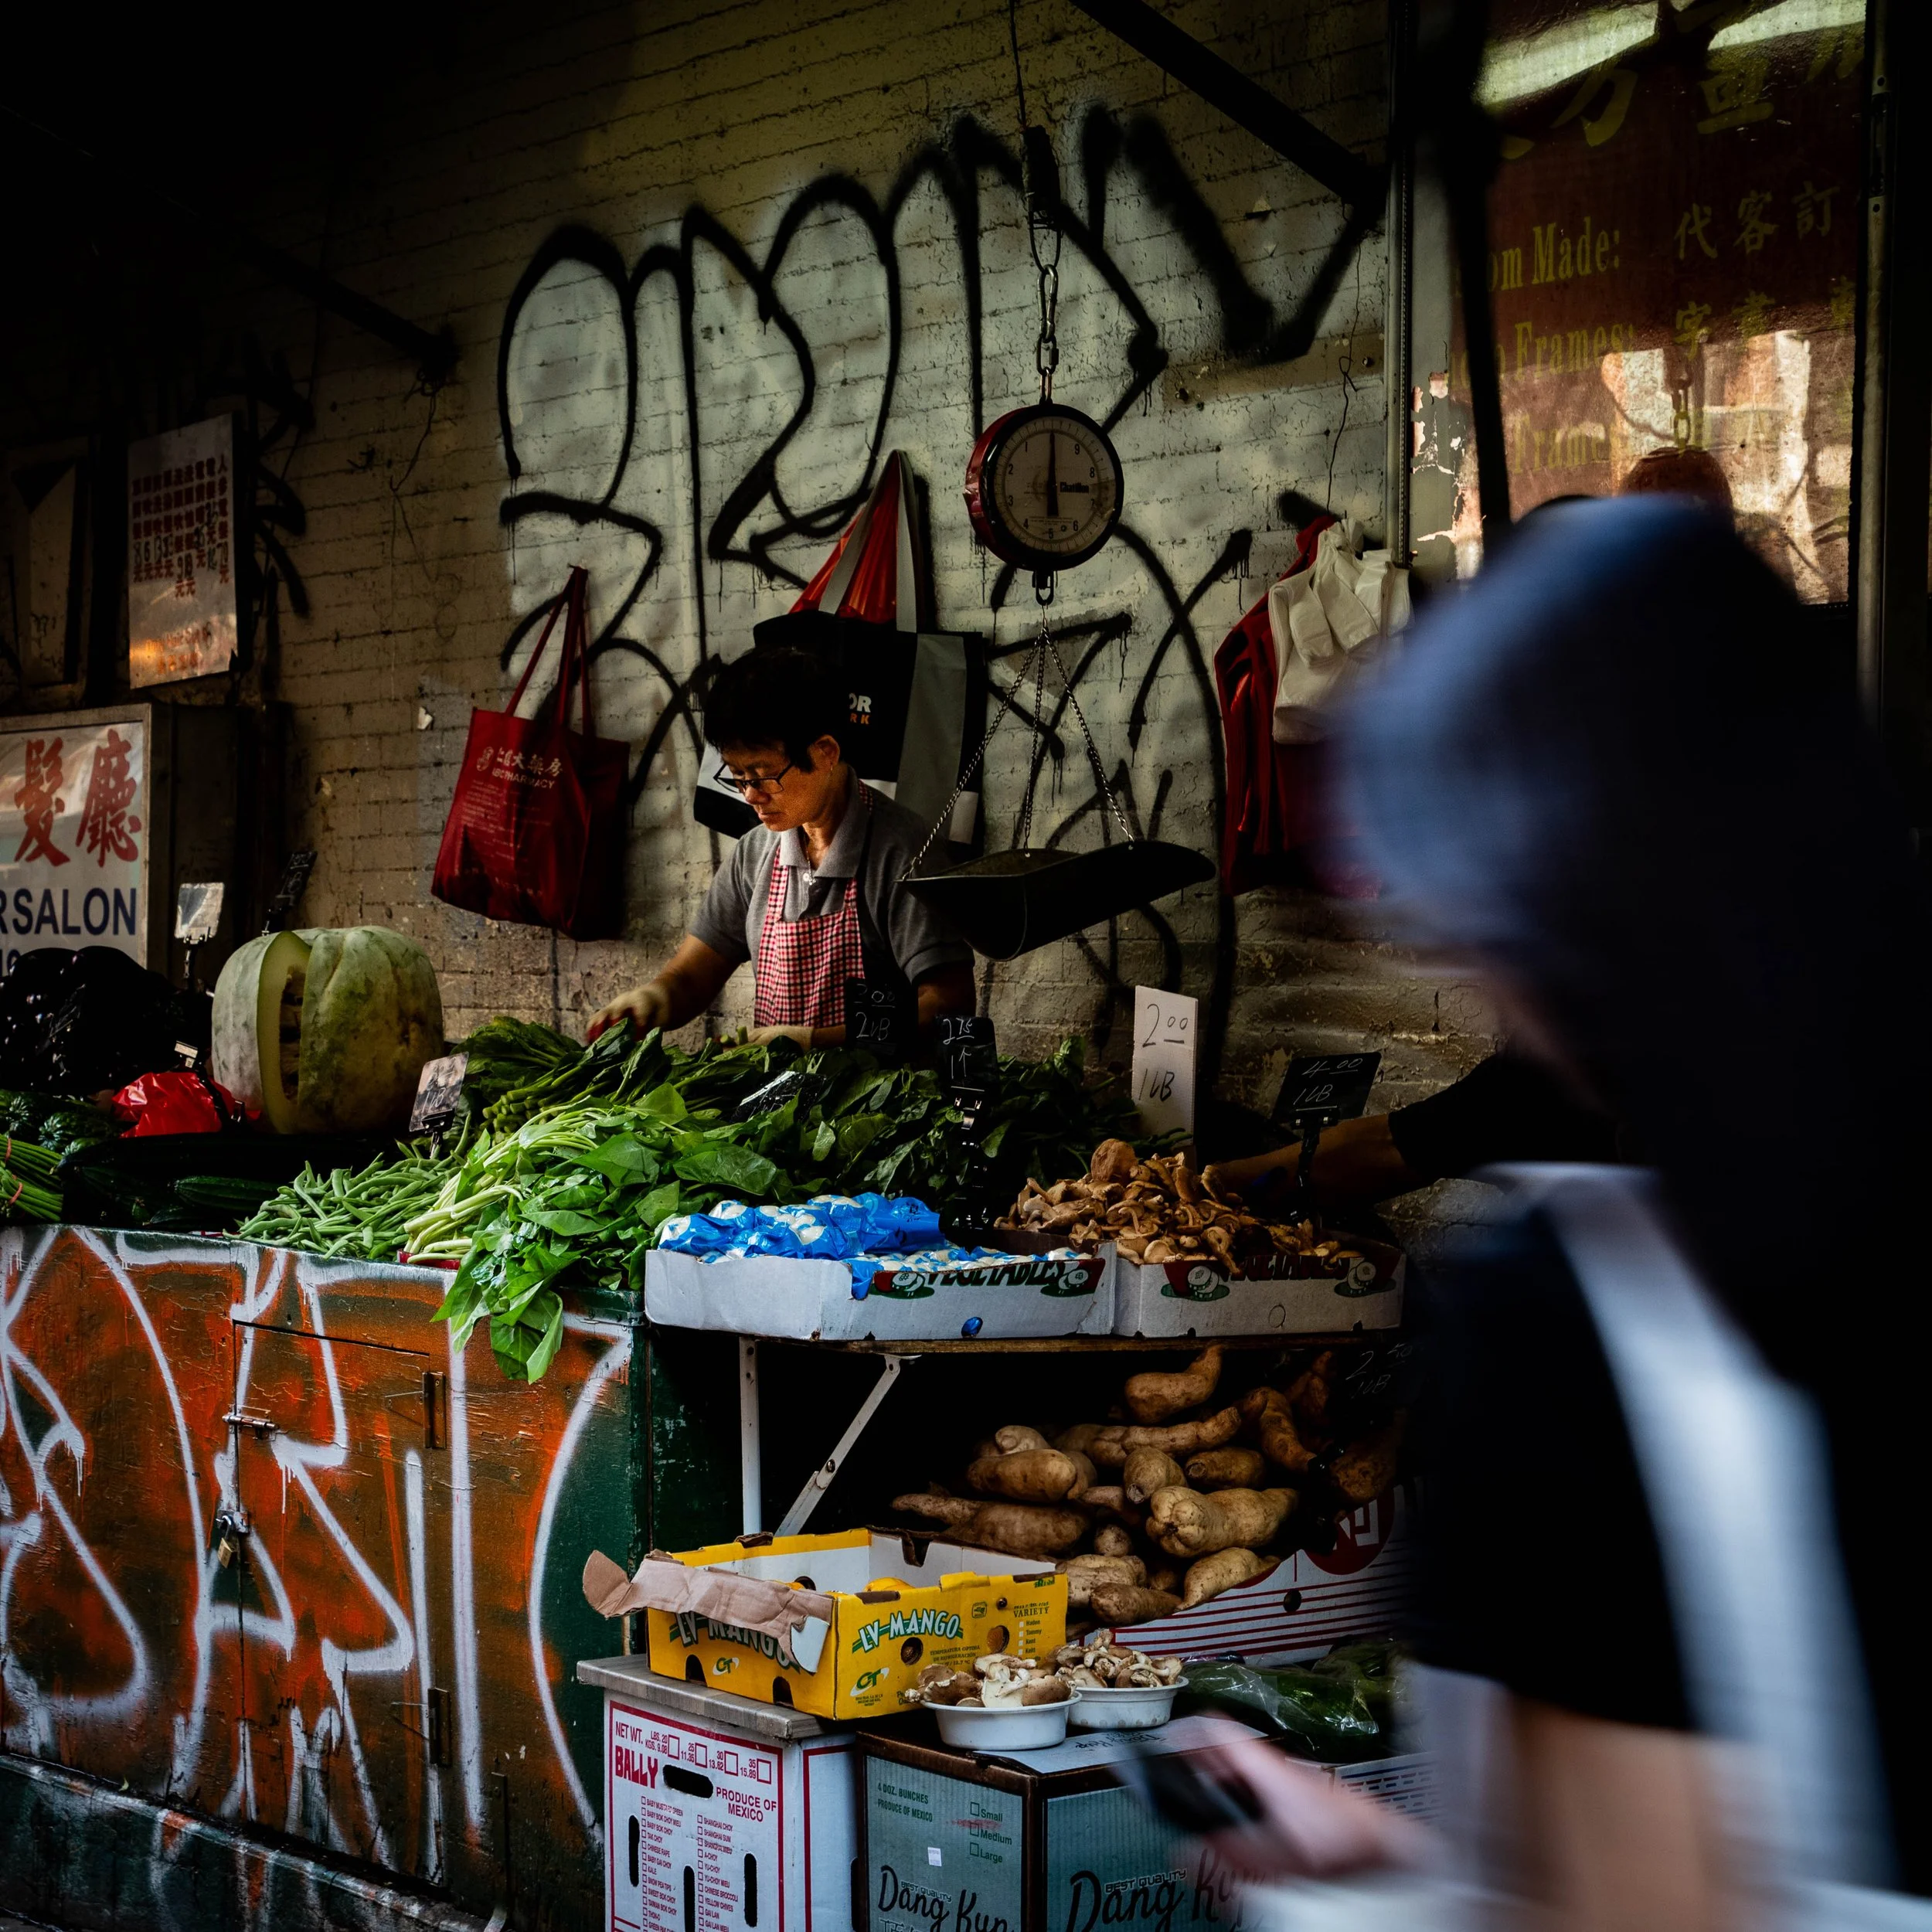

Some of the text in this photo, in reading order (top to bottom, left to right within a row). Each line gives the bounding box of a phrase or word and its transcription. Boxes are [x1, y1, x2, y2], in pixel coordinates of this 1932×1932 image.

[1532, 216, 1620, 284] Made:
[1074, 444, 1080, 455] 9
[1008, 464, 1014, 474] 2
[1090, 467, 1095, 478] 8
[1007, 495, 1014, 507] 3
[1023, 519, 1029, 529] 4
[1073, 520, 1079, 532] 6
[1048, 528, 1054, 539] 5
[1013, 1607, 1049, 1618] VARIETY
[858, 1618, 881, 1653] LV
[889, 1607, 961, 1641] MANGO
[615, 1721, 629, 1740] NET
[630, 1726, 643, 1744] WT.
[661, 1734, 668, 1744] 20
[716, 1750, 723, 1760] 30
[615, 1745, 658, 1790] BALLY
[748, 1758, 756, 1769] 35
[740, 1767, 757, 1779] 15.89
[716, 1786, 777, 1811] PRODUCE OF
[883, 1784, 897, 1795] DOZ.
[899, 1788, 929, 1804] BUNCHES
[728, 1802, 764, 1822] MEXICO
[877, 1798, 933, 1823] PRODUCE OF MEXICO
[981, 1808, 1003, 1823] Small
[980, 1828, 1012, 1845] Medium
[980, 1848, 1003, 1864] Large
[1104, 1867, 1188, 1893] BEST QUALITY
[878, 1864, 950, 1932] Dang
[1066, 1869, 1185, 1932] Dang
